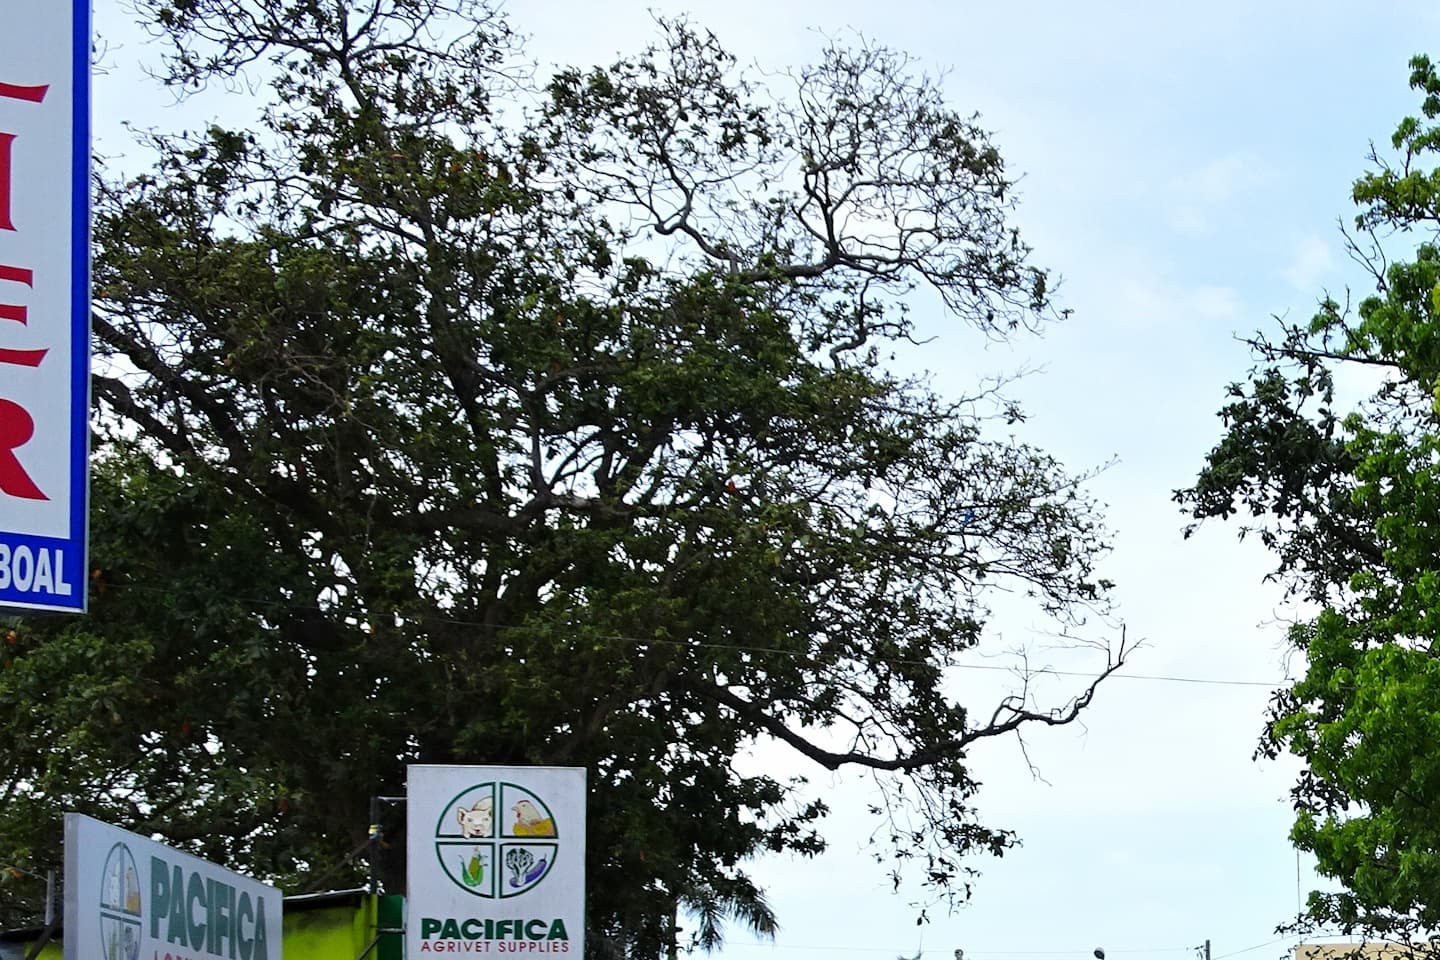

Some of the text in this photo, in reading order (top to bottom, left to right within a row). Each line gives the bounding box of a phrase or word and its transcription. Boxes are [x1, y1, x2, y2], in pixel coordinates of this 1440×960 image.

[421, 918, 569, 940] PACIFICA
[420, 941, 569, 952] AGRIVET SUPPLIES
